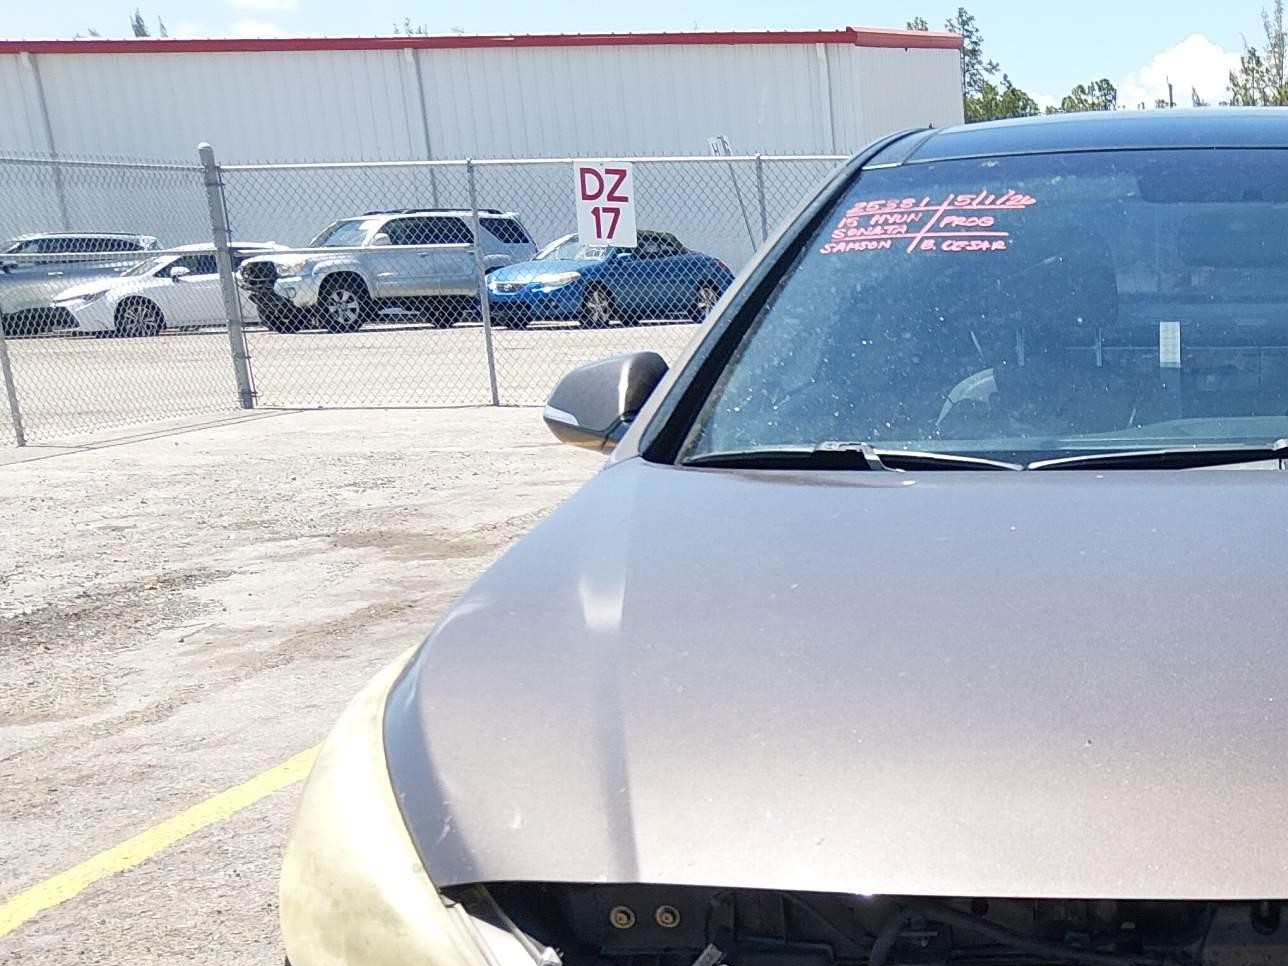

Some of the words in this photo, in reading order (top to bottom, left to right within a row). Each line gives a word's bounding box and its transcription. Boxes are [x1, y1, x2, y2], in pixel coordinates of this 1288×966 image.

[579, 167, 629, 202] DZ
[591, 206, 621, 239] 17
[870, 213, 922, 225] HYUN
[820, 240, 892, 254] SAMSON
